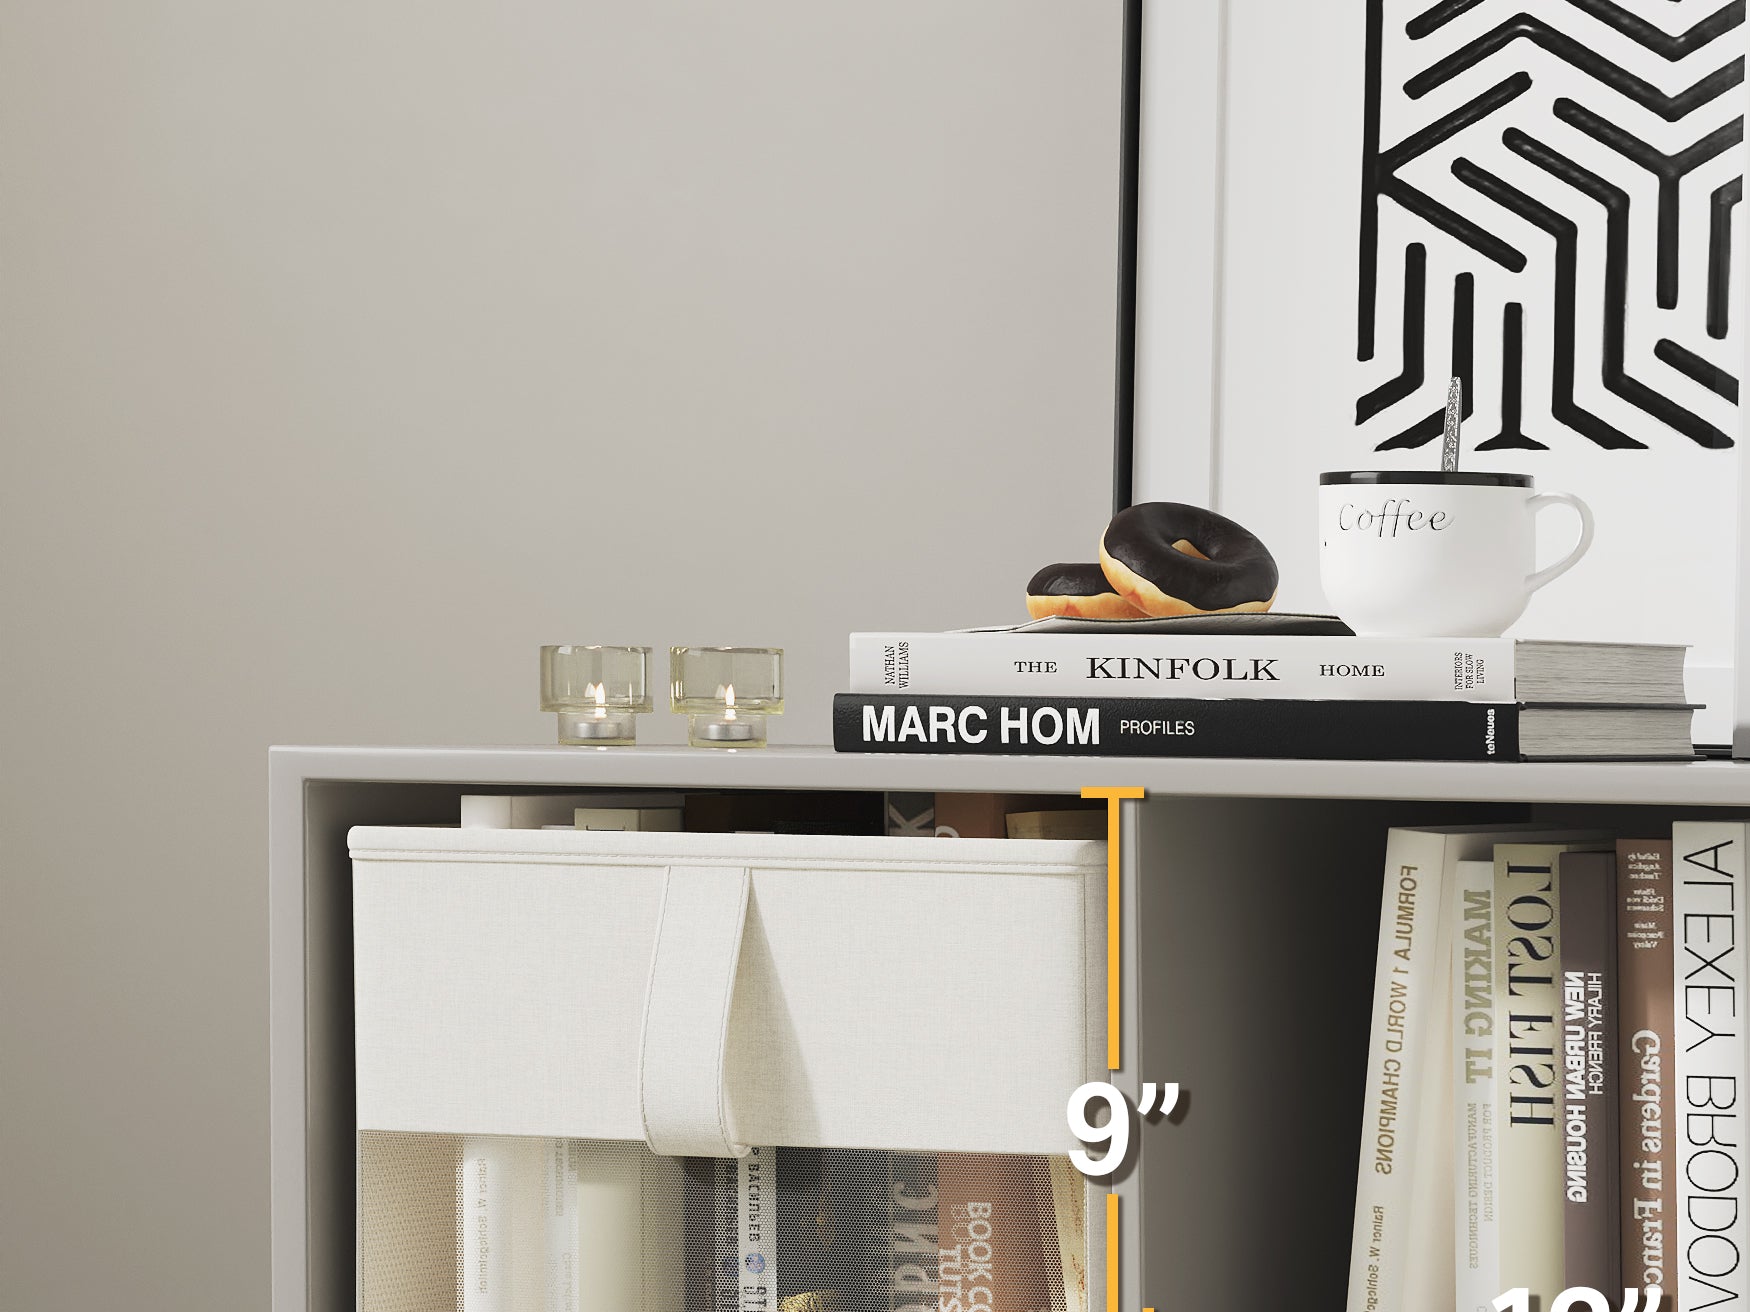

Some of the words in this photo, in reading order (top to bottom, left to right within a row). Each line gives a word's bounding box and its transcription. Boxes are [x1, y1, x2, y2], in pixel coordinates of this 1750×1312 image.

[1339, 499, 1454, 537] Coffee
[885, 646, 895, 685] NATHAN
[899, 641, 909, 689] WILLIAMS
[1014, 661, 1058, 673] THE
[1086, 656, 1280, 681] KINFOLK
[1320, 664, 1385, 677] HOME
[1454, 652, 1463, 690] INTERIORS
[1465, 653, 1473, 672] SLOW
[1465, 673, 1473, 689] FOR
[1476, 659, 1485, 684] LIVING
[863, 704, 988, 744] MARC
[1001, 706, 1100, 745] HOM
[1120, 719, 1194, 736] PROFILES
[967, 1201, 993, 1281] BOOK
